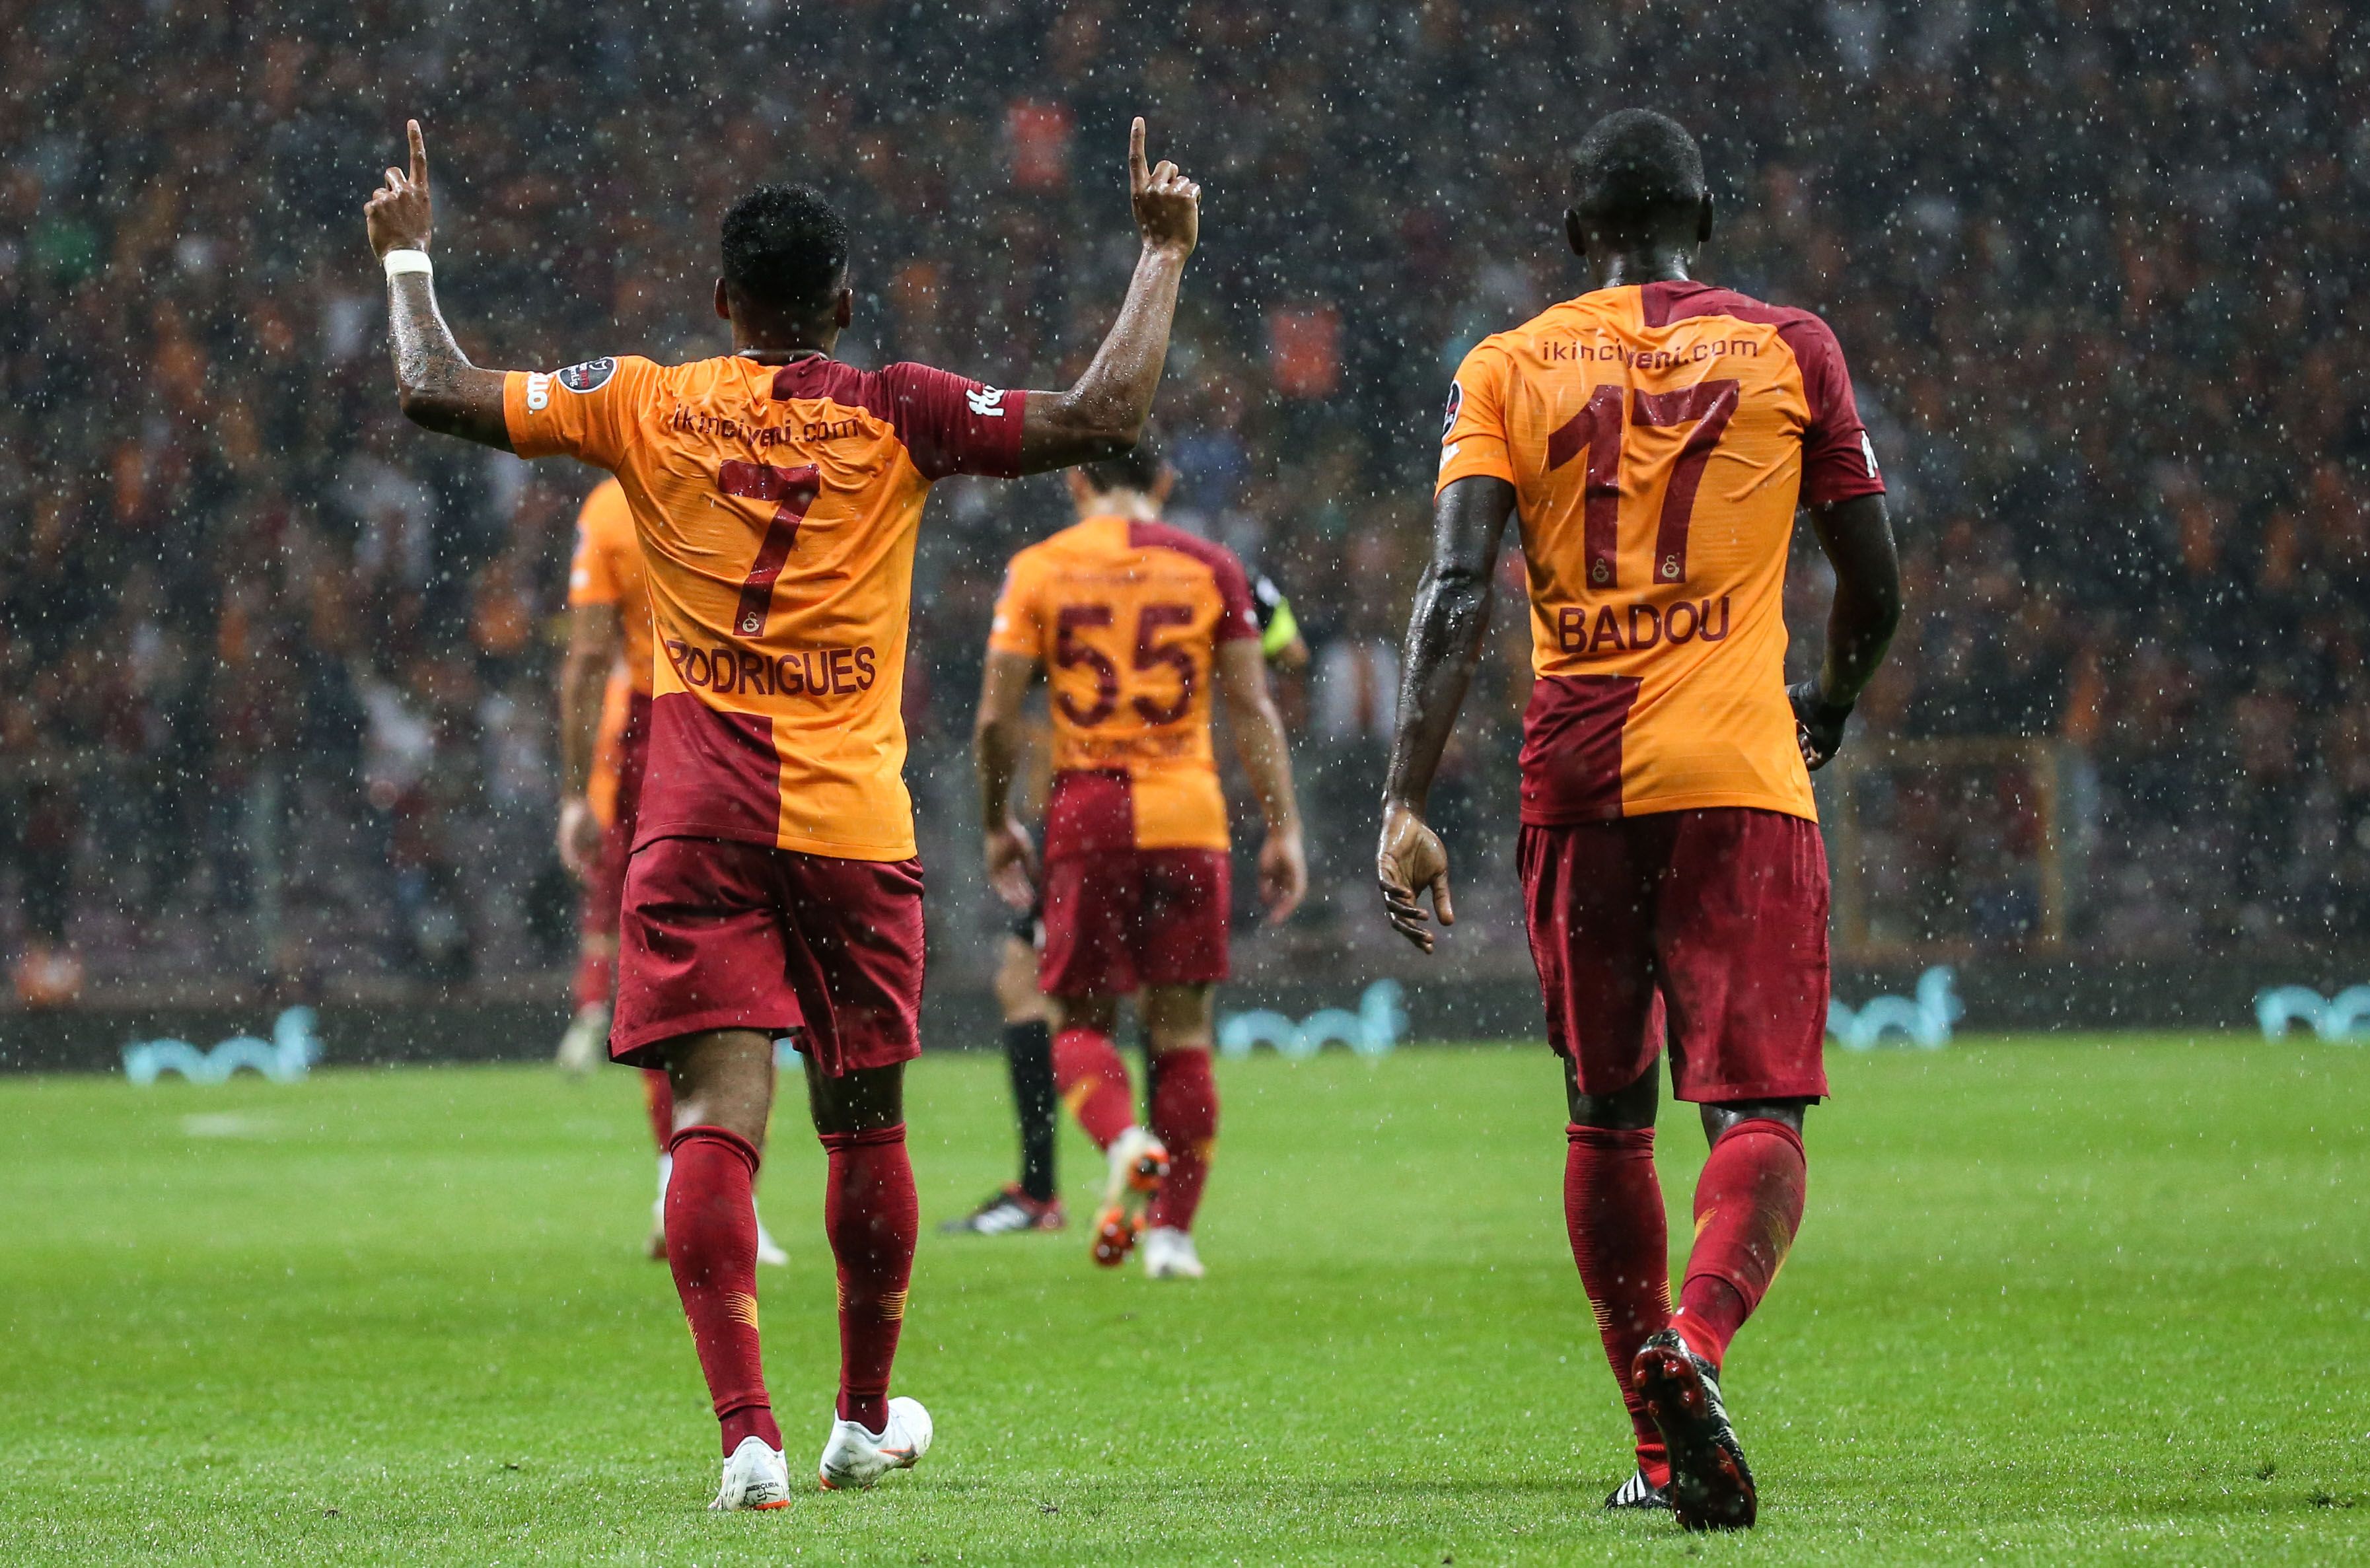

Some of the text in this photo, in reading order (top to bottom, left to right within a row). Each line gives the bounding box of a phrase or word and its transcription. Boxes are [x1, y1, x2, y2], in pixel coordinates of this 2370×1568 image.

[1543, 338, 1758, 369] ikinciyeni.com
[673, 403, 859, 448] ikinciyeni.com
[1548, 378, 1739, 589] 17
[717, 458, 821, 637] 7
[1558, 596, 1730, 654] BADOU
[666, 639, 876, 697] RODRIGUES
[1056, 604, 1195, 727] 55
